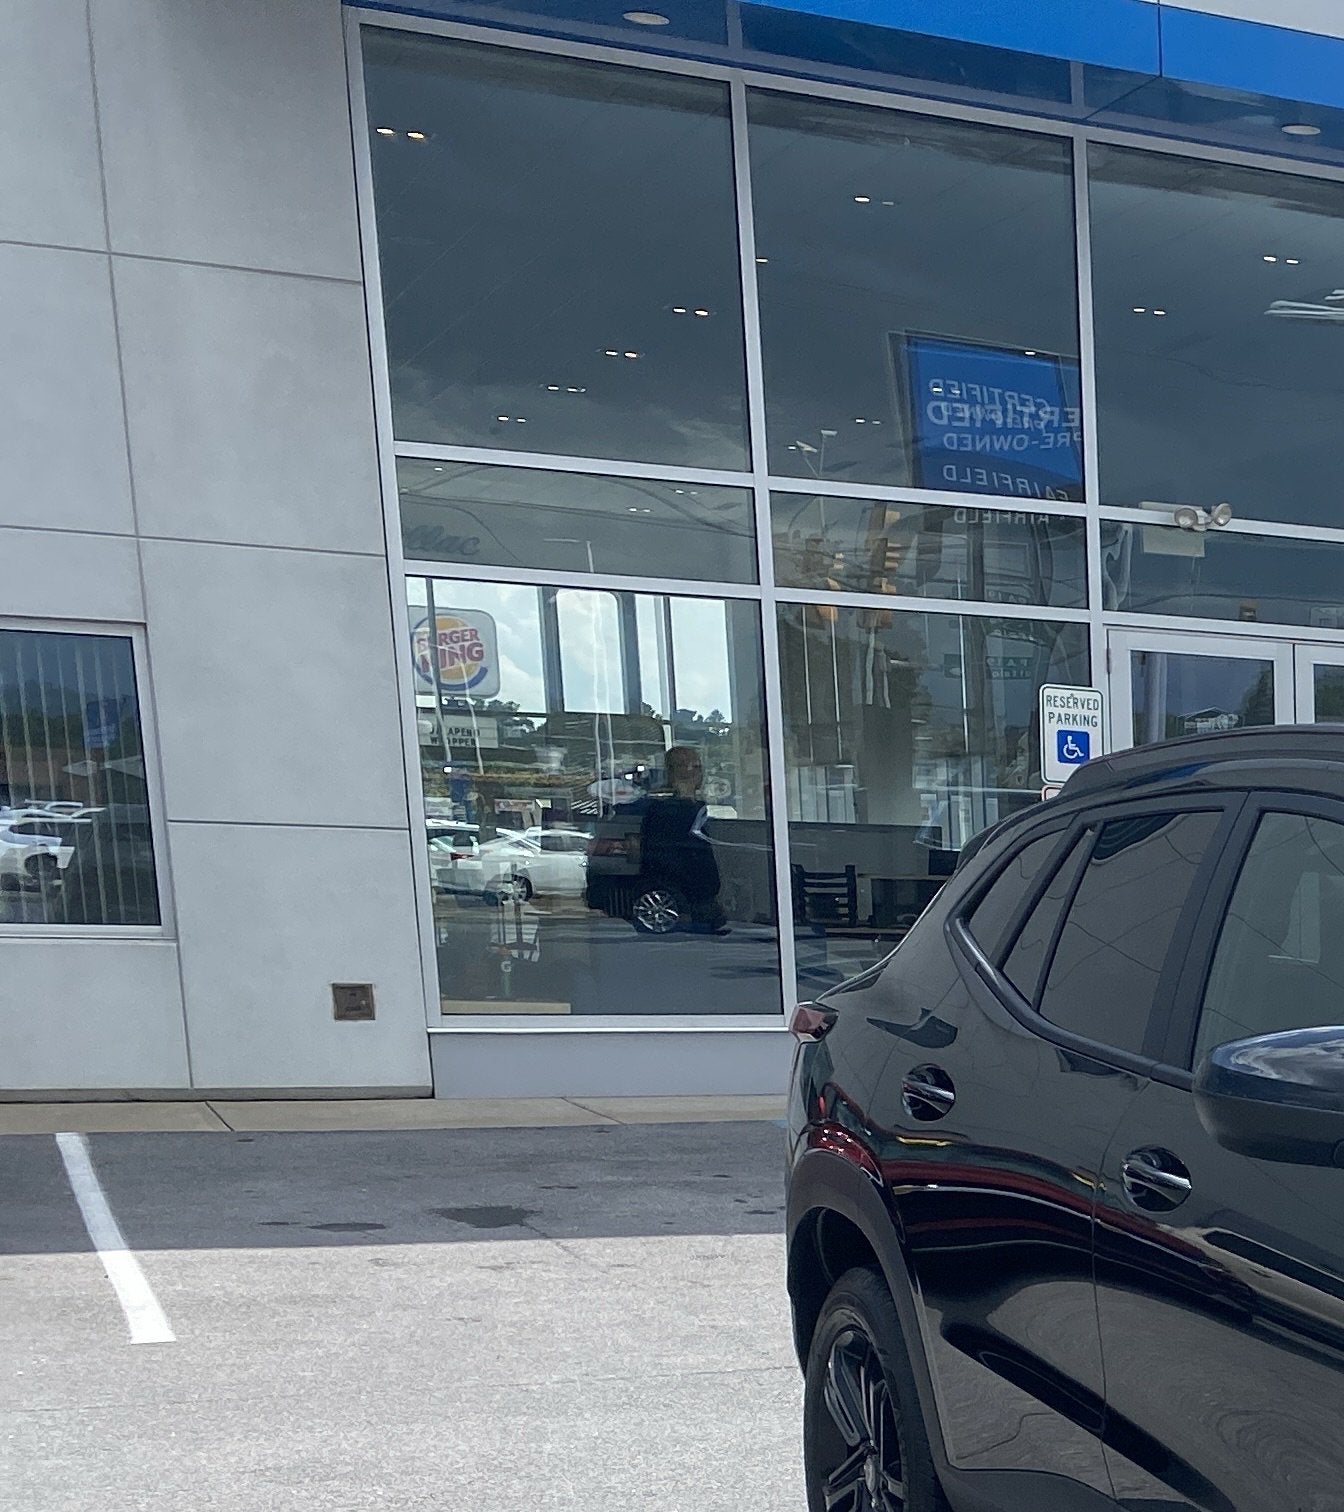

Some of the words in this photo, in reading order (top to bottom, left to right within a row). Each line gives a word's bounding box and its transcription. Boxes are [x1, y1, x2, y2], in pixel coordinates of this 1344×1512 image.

[416, 628, 480, 650] BRGER
[1046, 695, 1099, 711] RESERVED
[1048, 712, 1098, 728] PARKING
